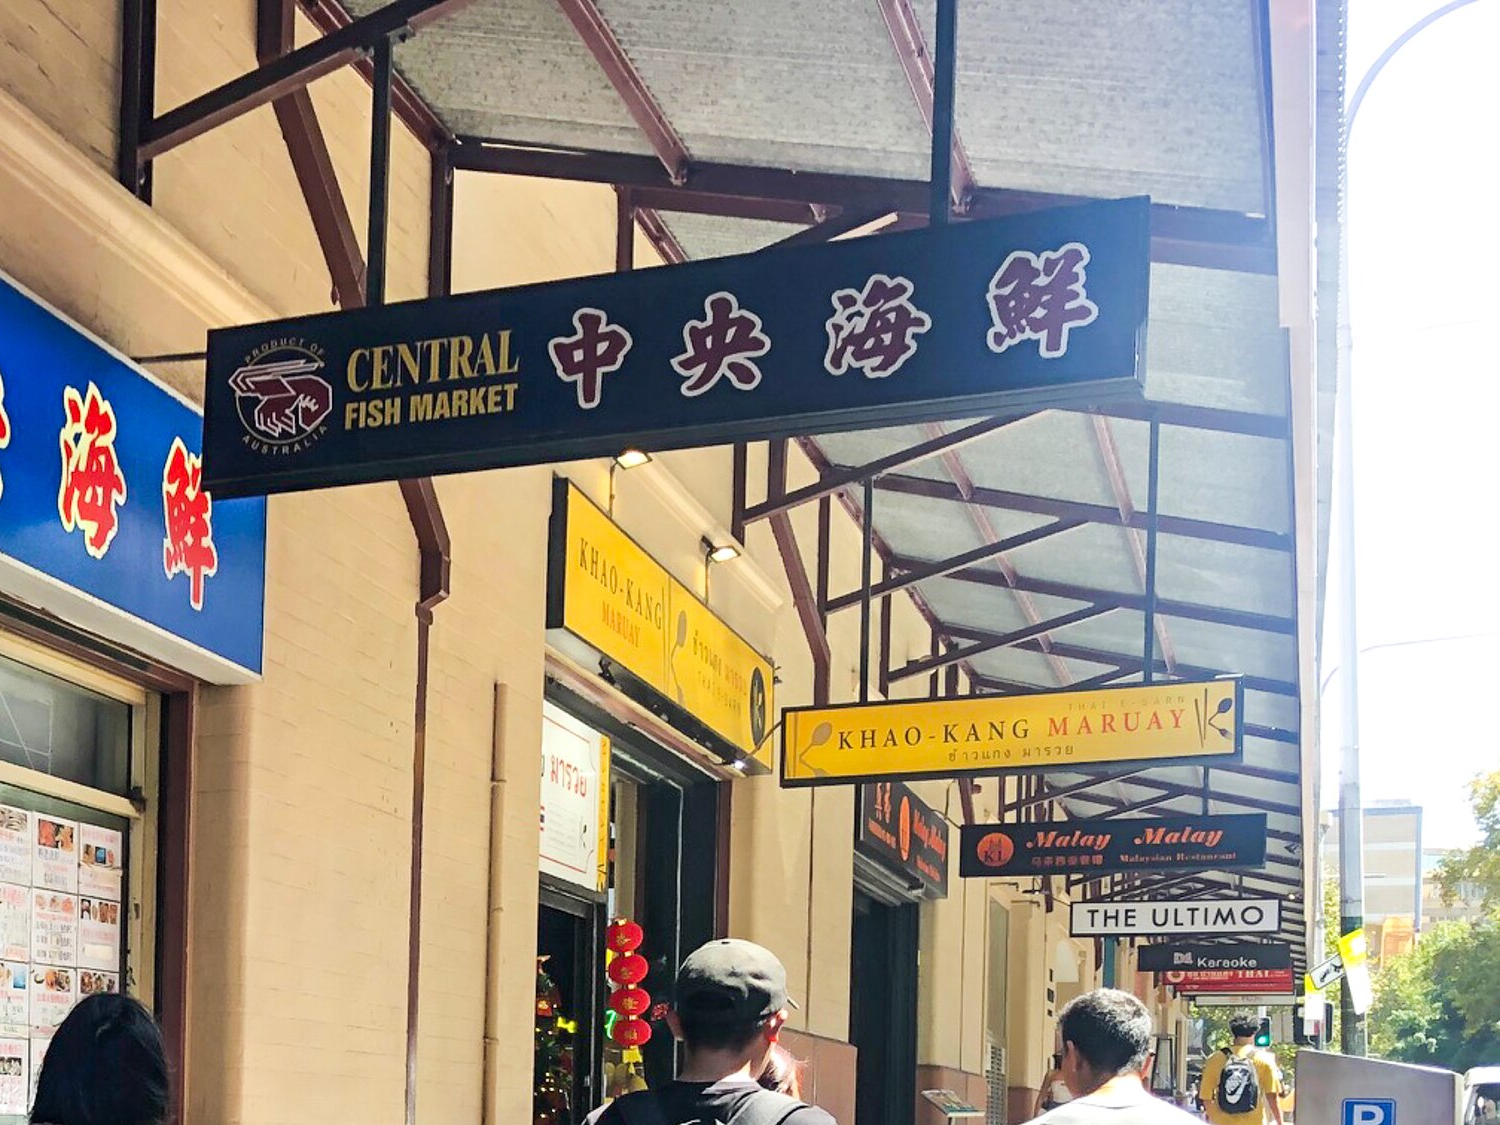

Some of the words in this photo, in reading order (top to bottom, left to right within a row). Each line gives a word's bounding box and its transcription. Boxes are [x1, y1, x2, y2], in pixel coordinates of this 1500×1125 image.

[547, 242, 1099, 409] 中央海鮮
[245, 337, 305, 364] PRODUCT
[347, 330, 520, 392] CENTRAL
[344, 399, 400, 429] FISH
[409, 383, 518, 422] MARKET
[242, 426, 328, 455] AUSTRALIA
[579, 537, 662, 630] KHAO-KANG
[602, 599, 641, 648] MARUAY
[839, 719, 1029, 750] KHAO-KANG
[1048, 709, 1187, 737] MARUAY
[1027, 830, 1112, 851] Malay
[1134, 826, 1224, 848] Malay
[1087, 908, 1137, 928] THE
[1152, 906, 1264, 927] ULTIMO
[1197, 956, 1258, 968] Karaoke
